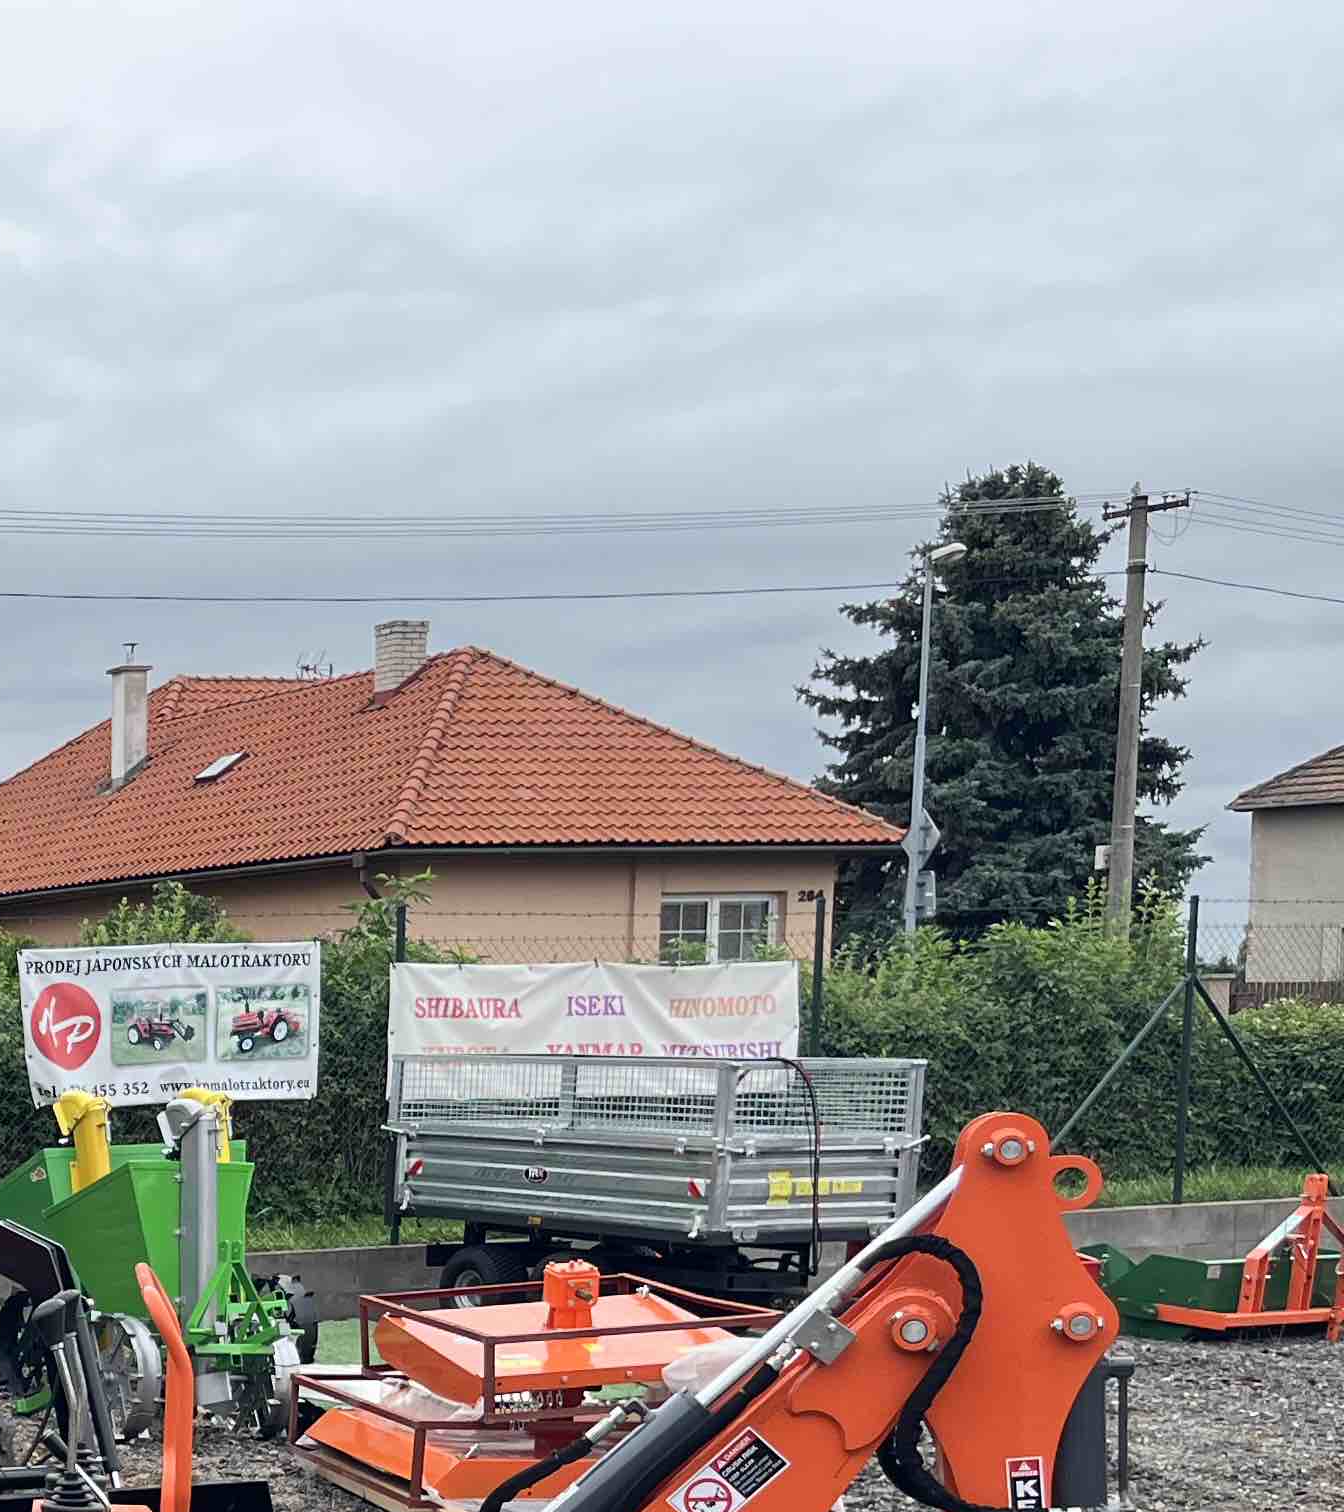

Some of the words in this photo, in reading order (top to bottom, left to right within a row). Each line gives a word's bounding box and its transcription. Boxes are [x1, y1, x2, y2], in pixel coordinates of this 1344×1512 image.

[25, 959, 82, 976] PRODEJ
[414, 996, 522, 1019] SHIBAURA
[566, 994, 626, 1017] ISEKI
[669, 993, 776, 1018] HINOMOTO
[123, 1081, 150, 1095] 352
[159, 1076, 310, 1094] wwwkpmalotraktory.eu
